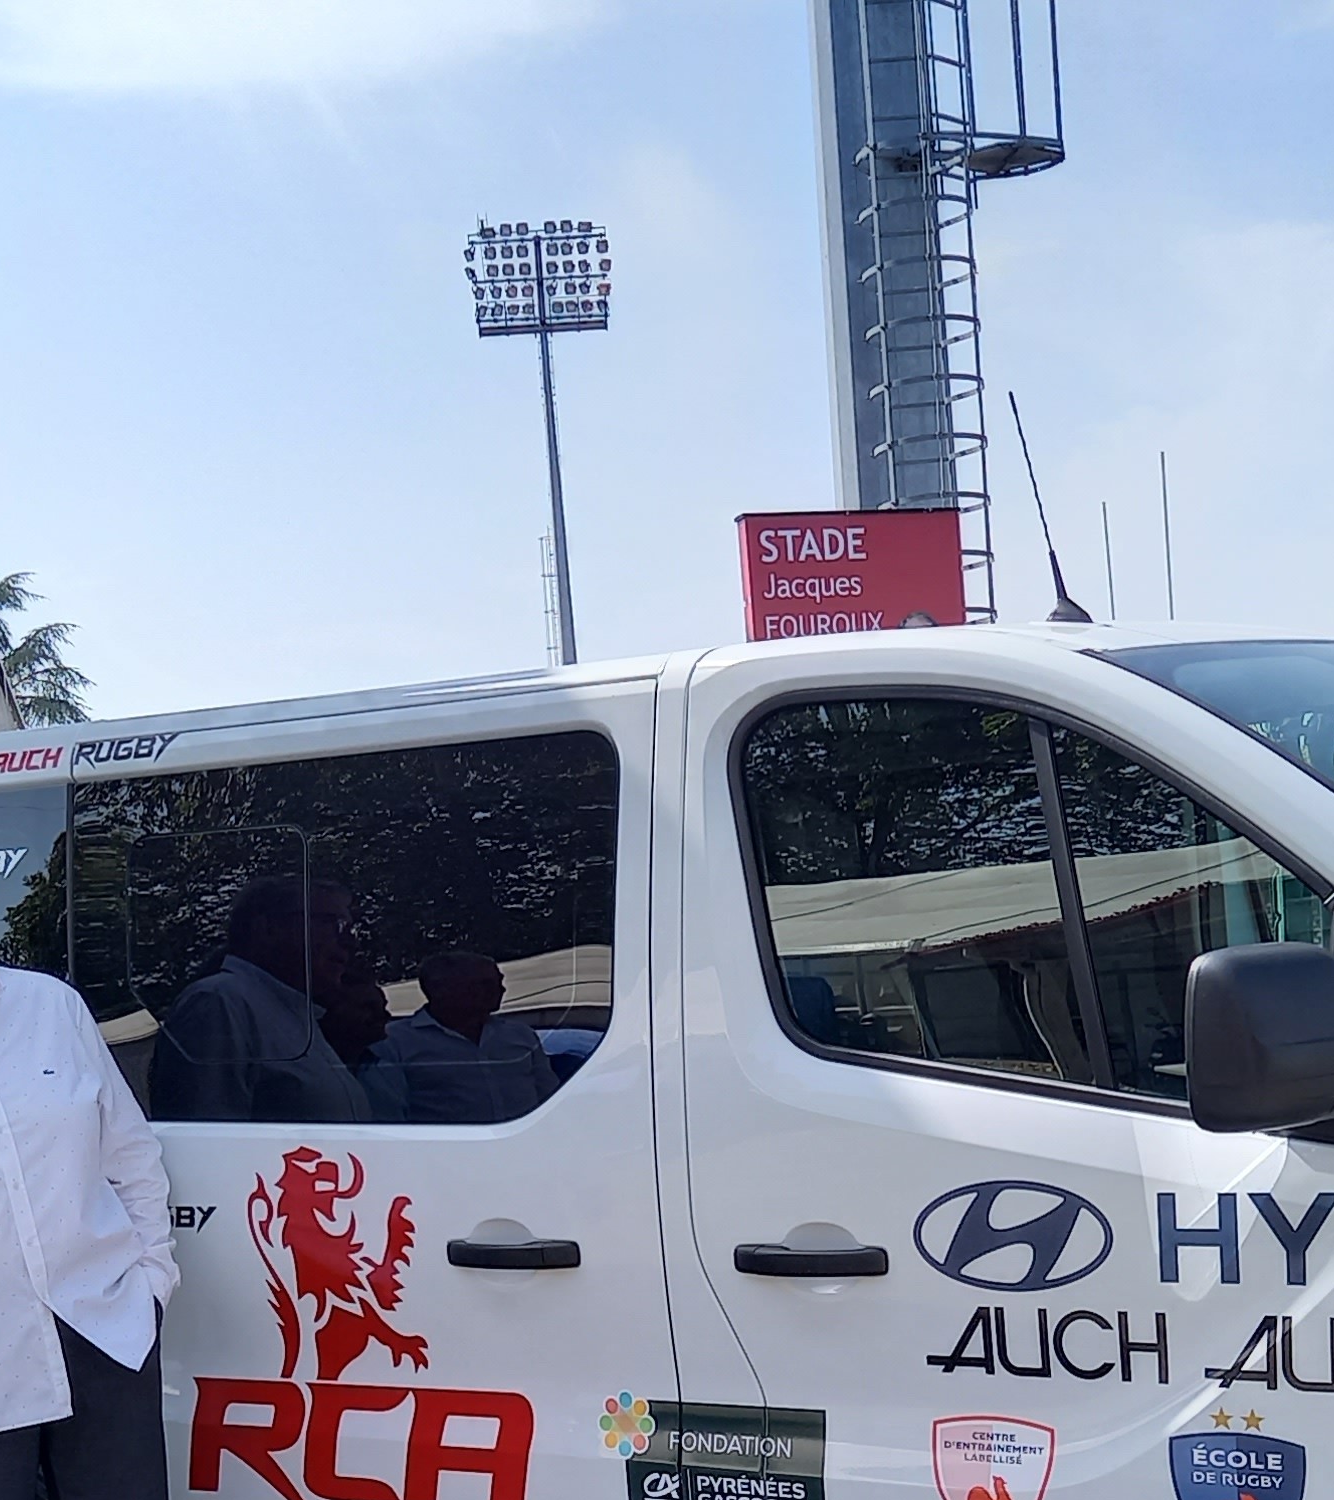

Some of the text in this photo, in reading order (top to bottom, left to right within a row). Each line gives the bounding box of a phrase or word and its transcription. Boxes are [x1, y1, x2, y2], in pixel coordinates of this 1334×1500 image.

[758, 526, 867, 563] STADE
[763, 573, 863, 604] Jacques
[765, 611, 884, 640] FOUROUX
[73, 731, 183, 770] RUGBY
[926, 1305, 1170, 1386] AUCH
[668, 1431, 792, 1459] FONDATION
[971, 1431, 1017, 1443] CENTRE
[963, 1453, 1023, 1465] LABELLISÉ
[1192, 1443, 1284, 1472] ÉCOLE
[696, 1474, 807, 1500] PYRÉNÉES
[1193, 1471, 1284, 1489] DE RUGBY
